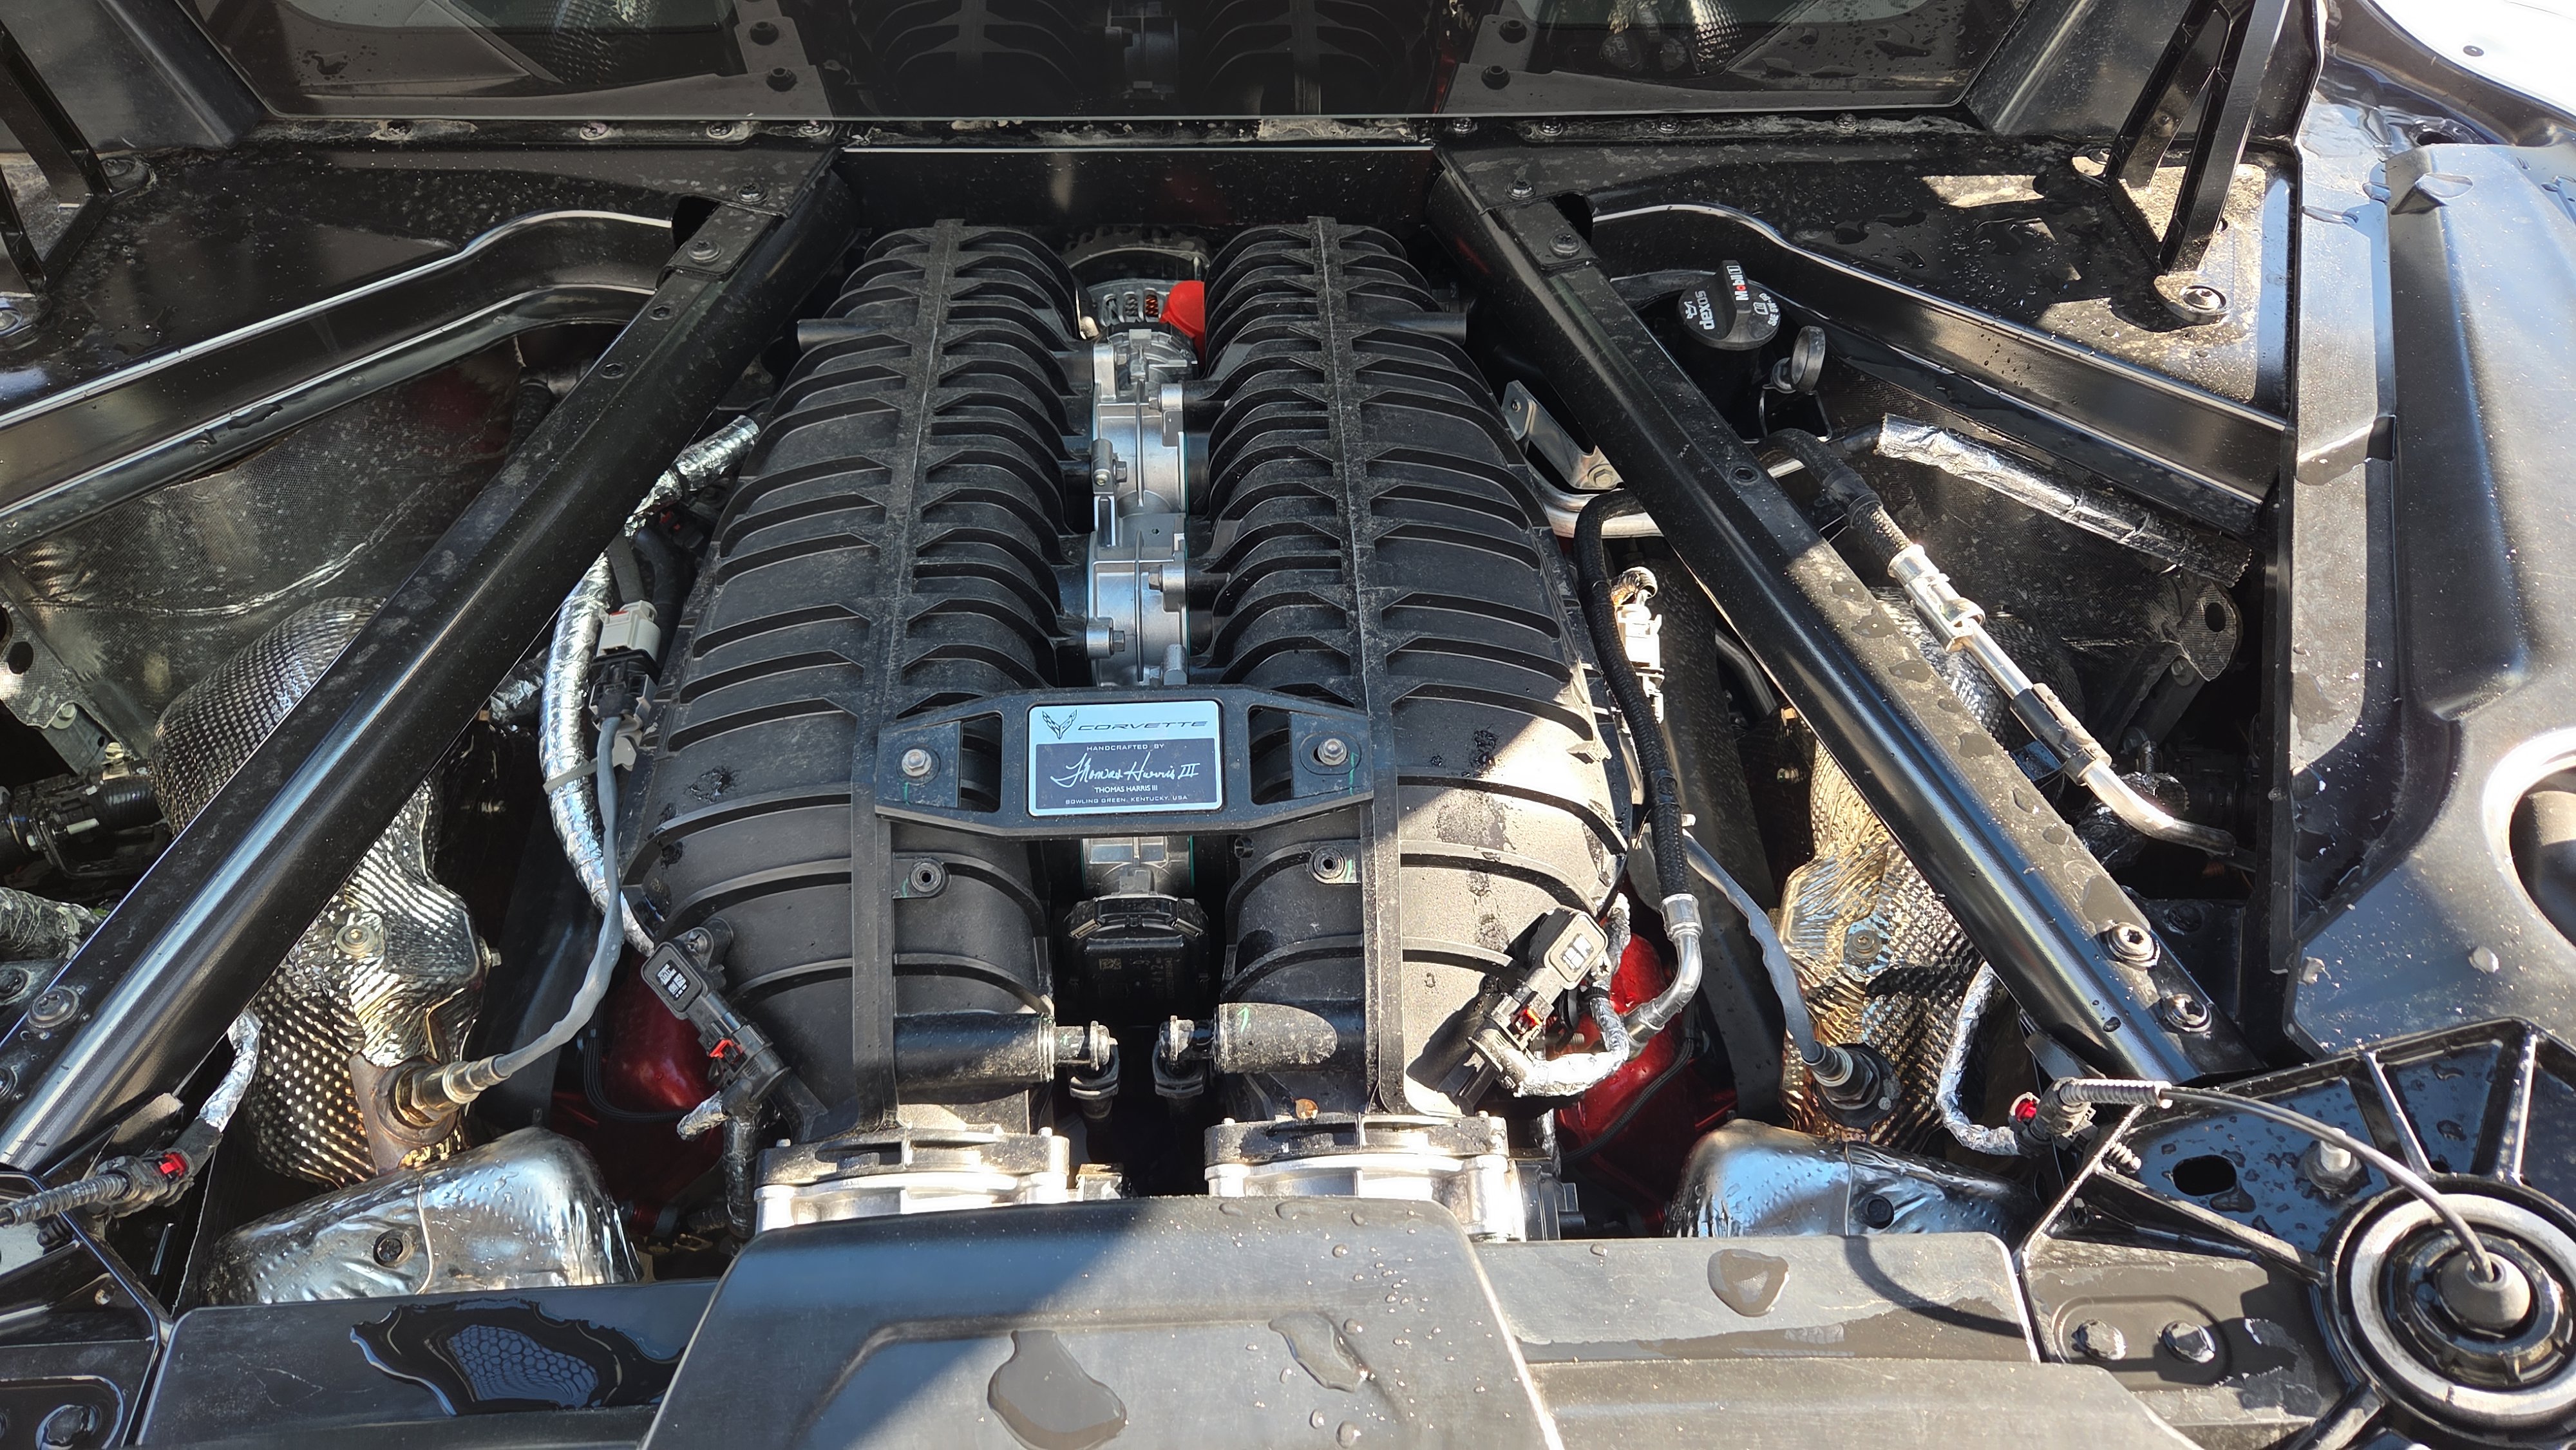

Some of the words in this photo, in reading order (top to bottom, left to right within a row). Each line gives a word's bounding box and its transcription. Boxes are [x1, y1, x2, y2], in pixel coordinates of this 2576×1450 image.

[1694, 290, 1716, 330] dexos
[1767, 313, 1779, 326] SAE
[1077, 720, 1208, 731] CORVETTE
[1086, 743, 1148, 752] HANDCRAFTED
[1050, 752, 1124, 788] Thomas
[1123, 751, 1175, 782] Harris
[1177, 762, 1201, 780] III
[1094, 786, 1125, 794] THOMAS
[1126, 784, 1151, 793] HARRIS
